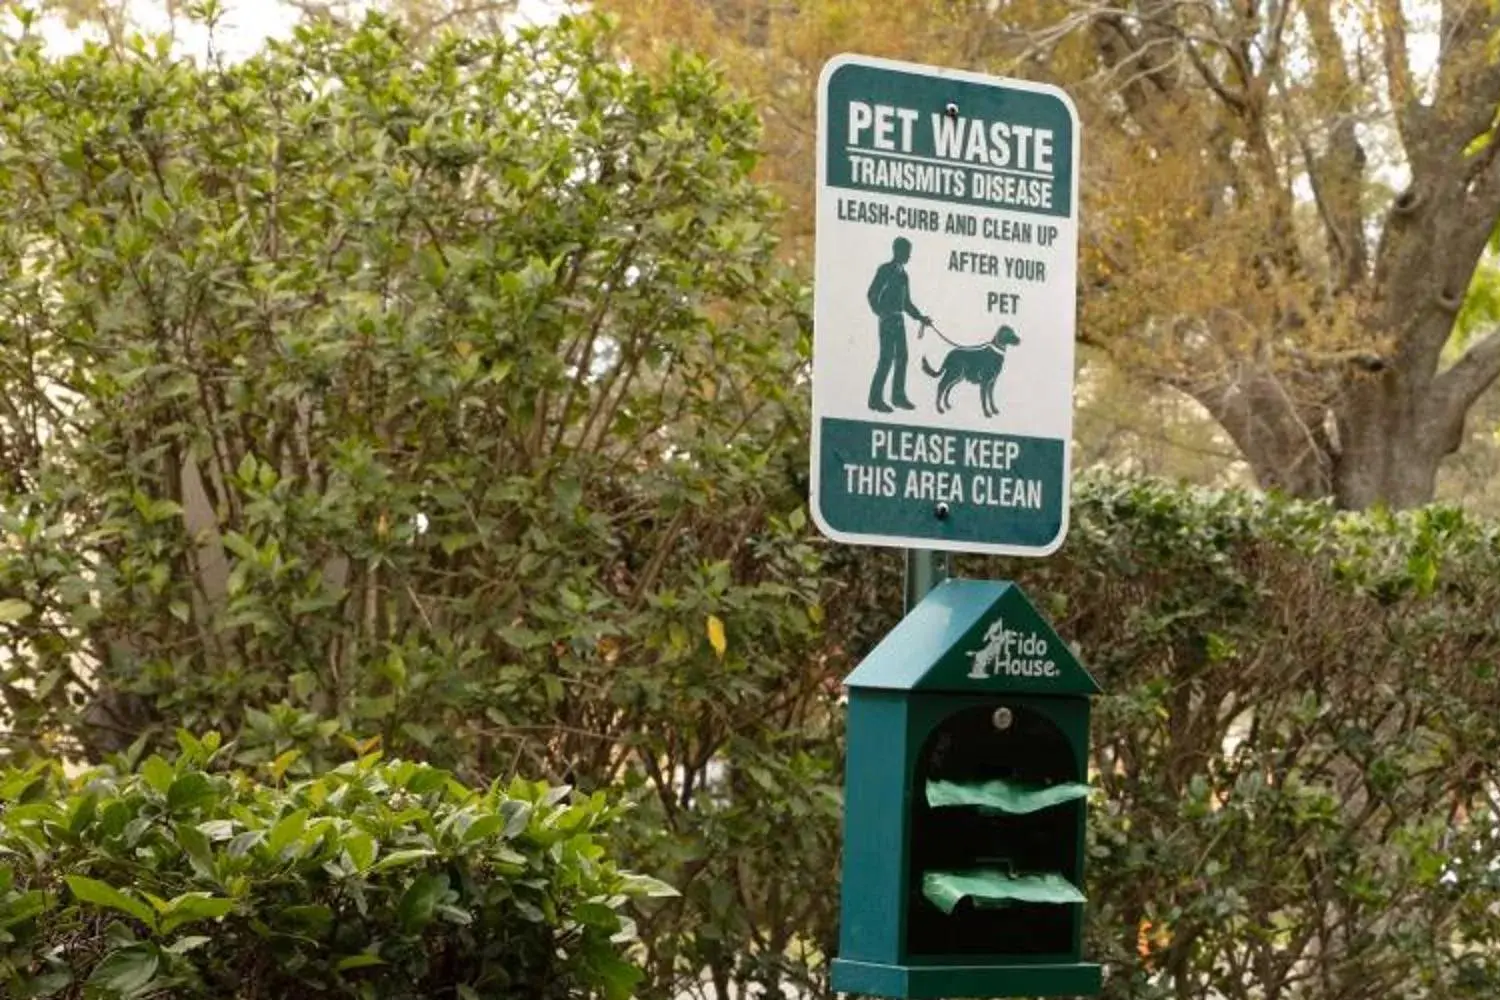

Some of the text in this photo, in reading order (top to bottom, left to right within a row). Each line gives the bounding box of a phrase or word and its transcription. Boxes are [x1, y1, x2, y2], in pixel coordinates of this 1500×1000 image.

[849, 101, 1053, 172] PET WASTE
[848, 155, 1053, 209] TRANSMITS DISEASE
[837, 199, 1058, 246] LEASH-CURB AND CLEAN UP
[948, 250, 1046, 282] AFTER YOUR
[987, 292, 1020, 315] PET
[871, 429, 1020, 470] PLEASE KEEP
[843, 464, 1043, 510] THIS AREA CLEAN
[1003, 629, 1048, 656] Fido
